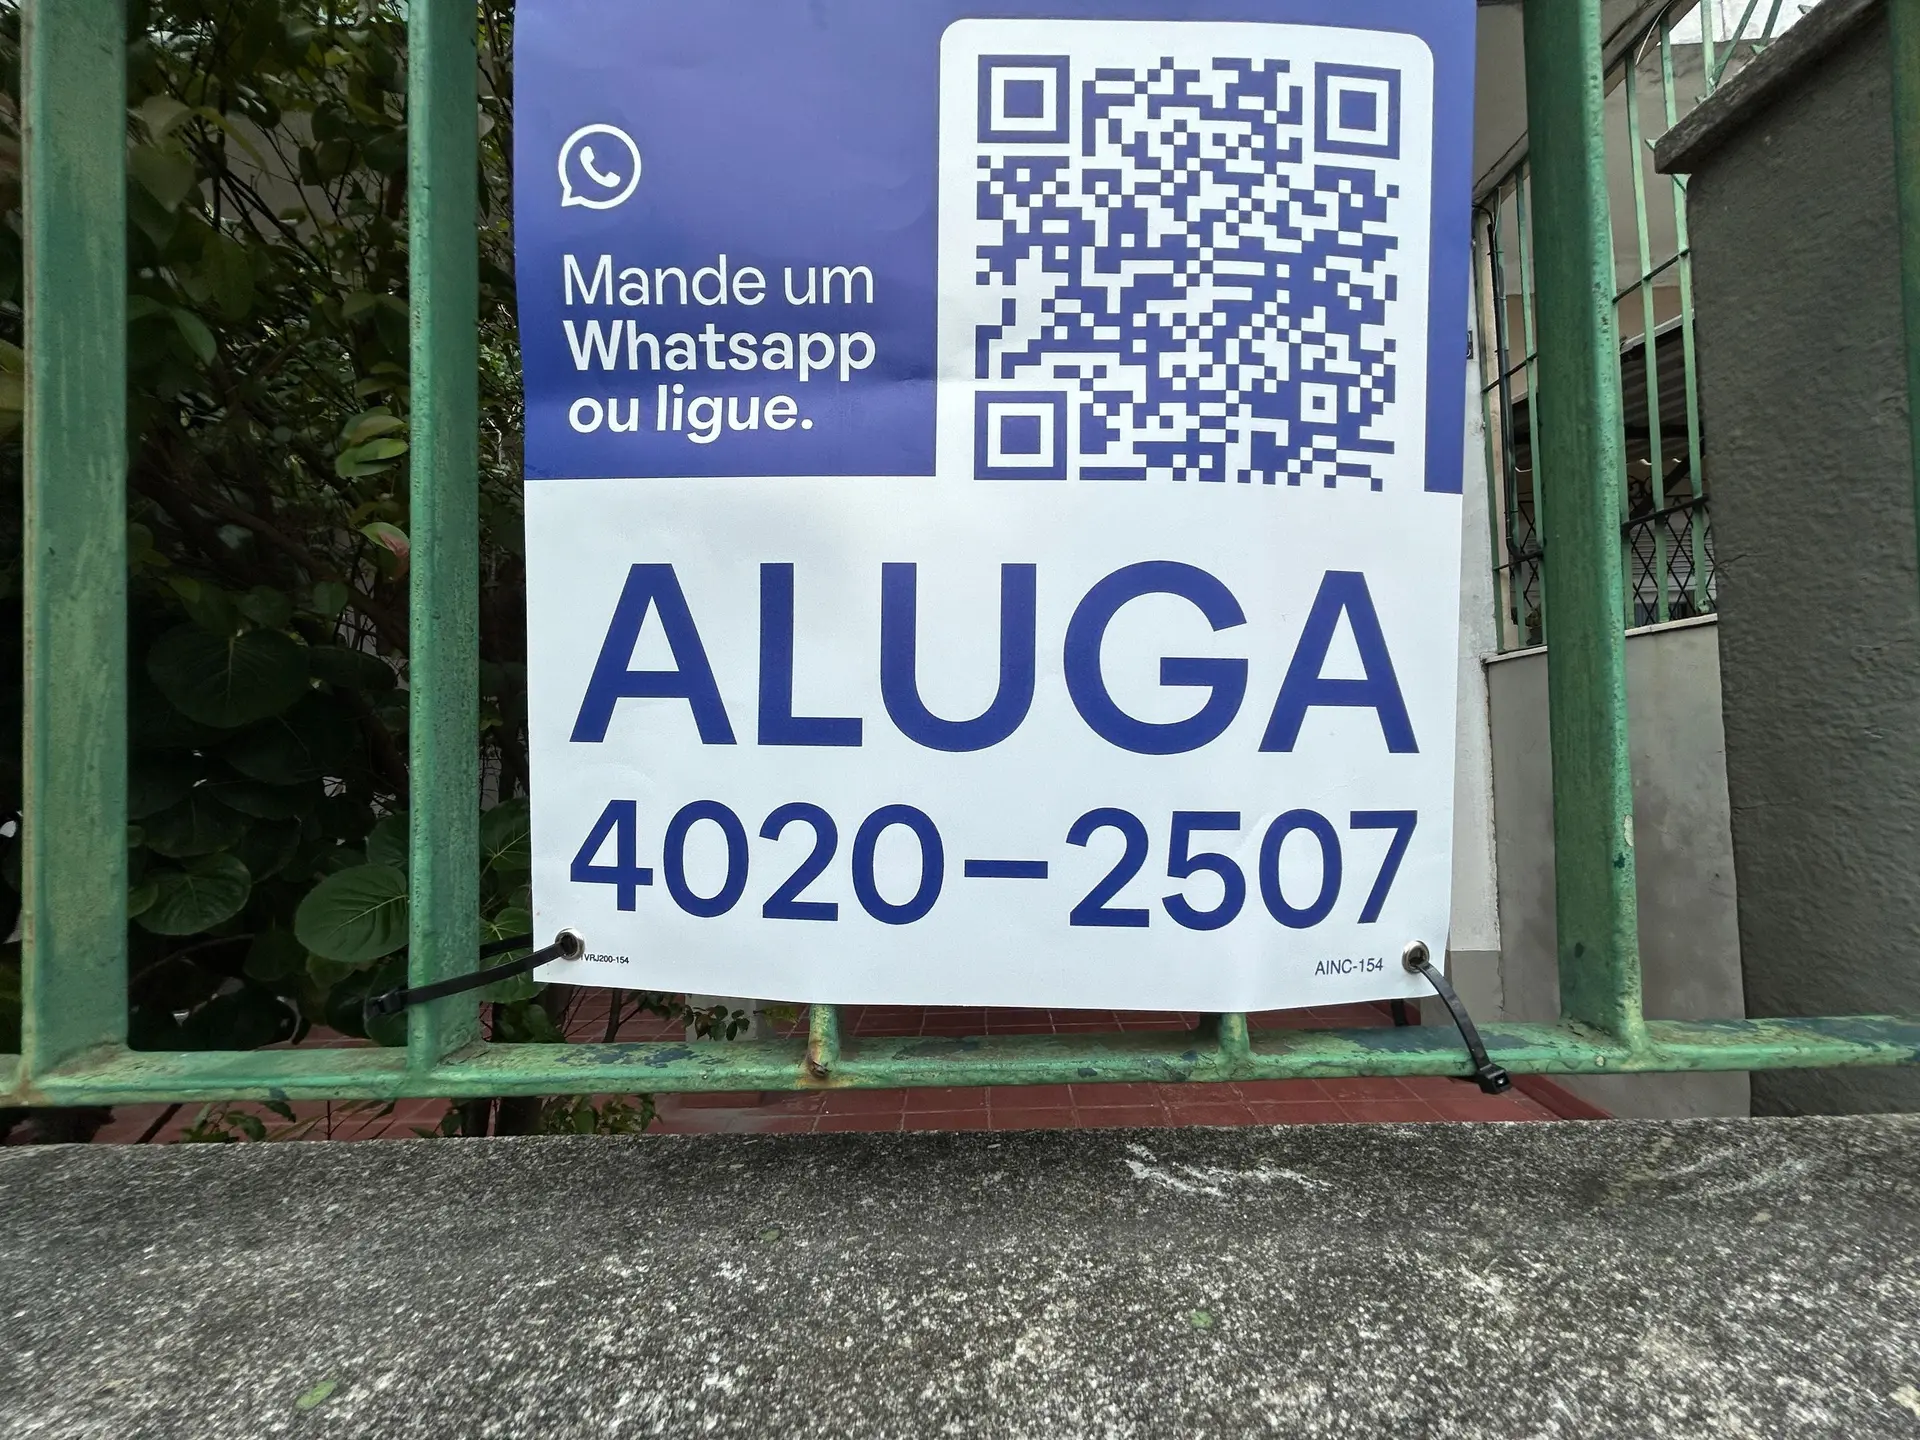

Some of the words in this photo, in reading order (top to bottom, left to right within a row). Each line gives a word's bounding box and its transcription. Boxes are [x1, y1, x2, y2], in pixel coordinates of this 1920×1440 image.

[563, 254, 766, 306] Mande
[784, 266, 874, 305] um
[563, 319, 876, 383] Whatsapp
[568, 397, 639, 434] ou
[657, 383, 814, 444] ligue.
[570, 559, 1420, 755] ALUGA
[569, 799, 1418, 931] 4020-2507
[1314, 957, 1384, 976] AINC-154
